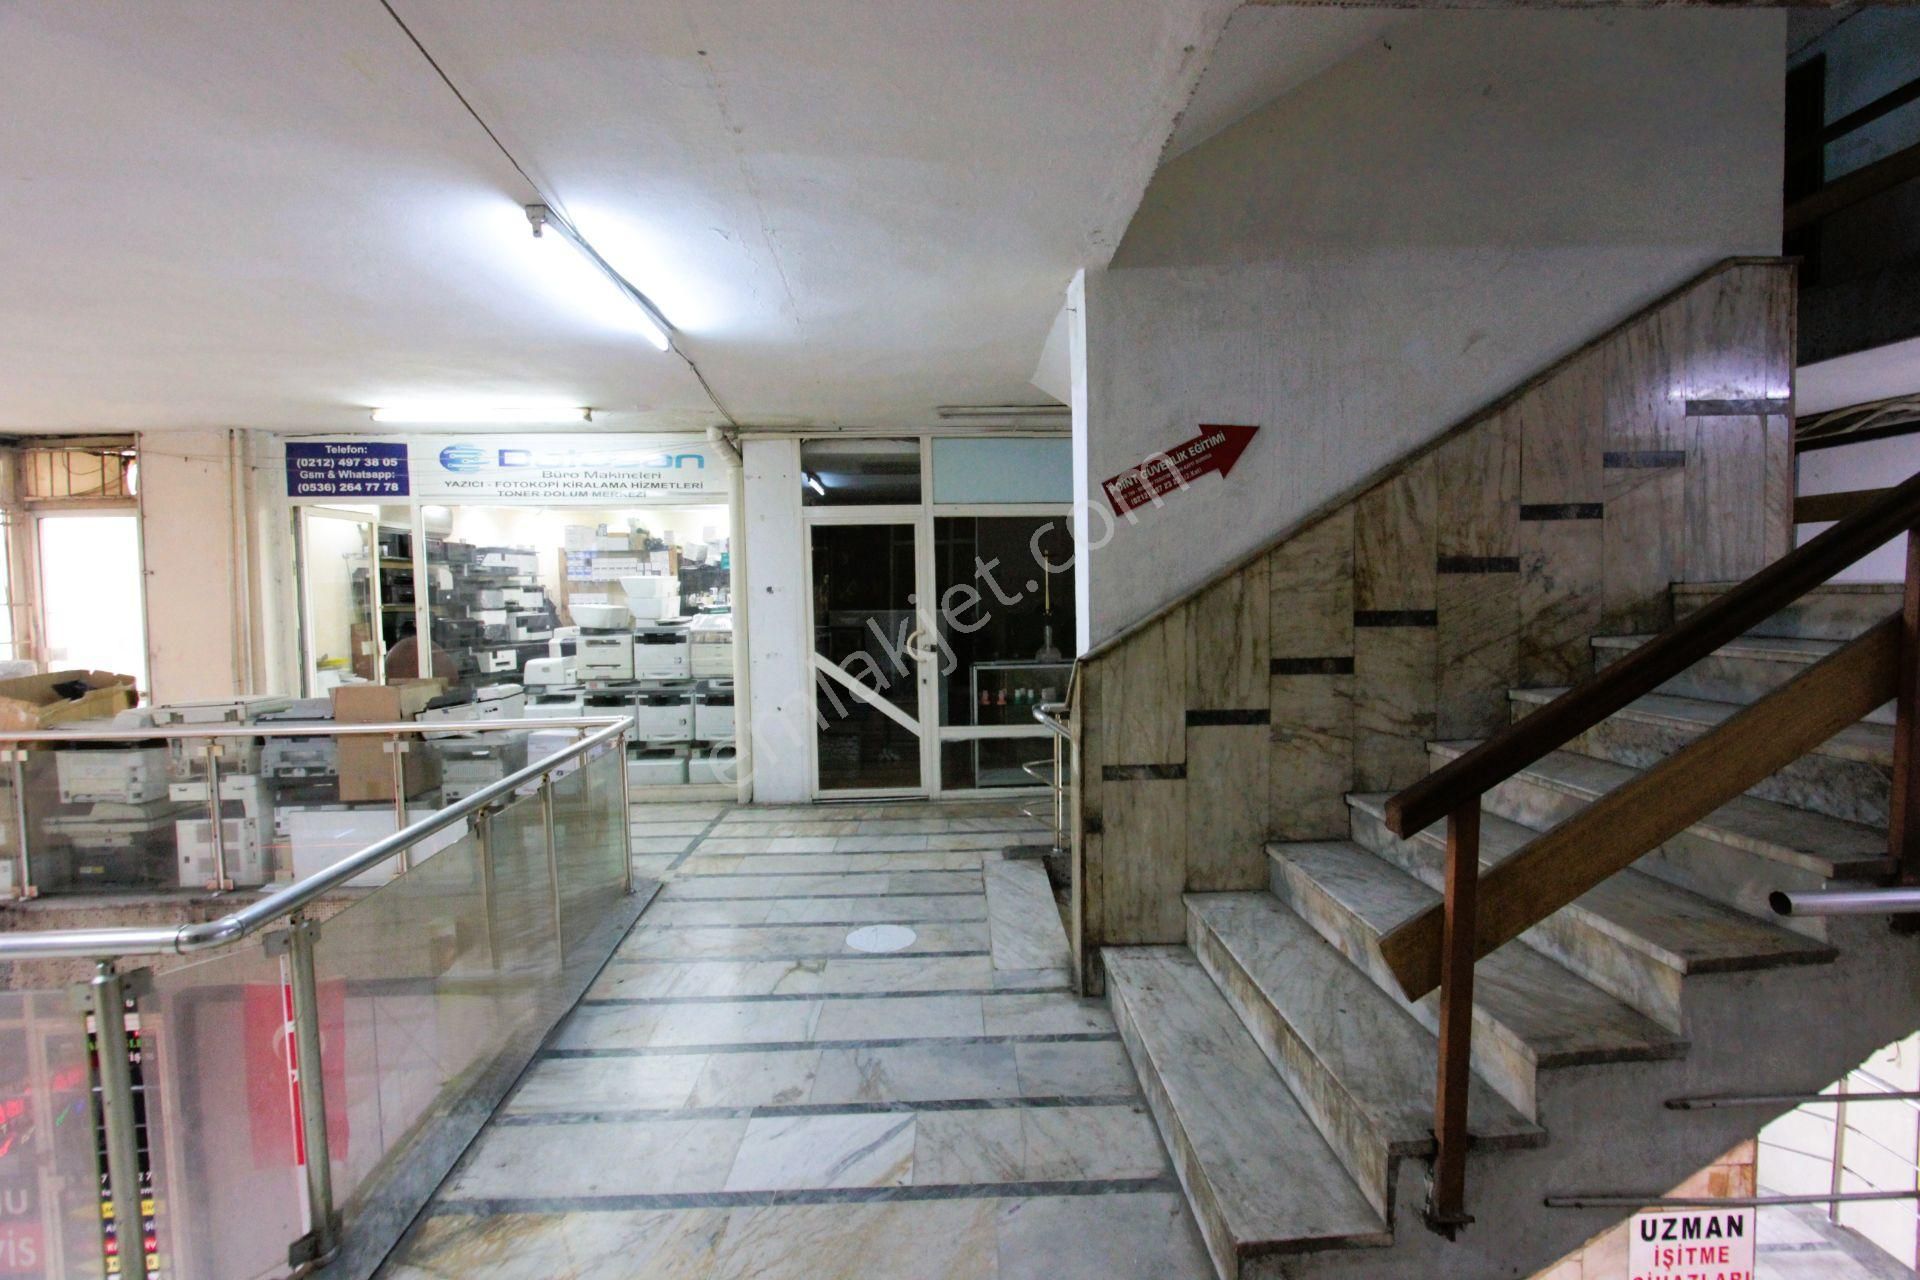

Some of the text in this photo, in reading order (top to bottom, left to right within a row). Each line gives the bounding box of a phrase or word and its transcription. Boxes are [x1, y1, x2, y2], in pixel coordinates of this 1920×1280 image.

[325, 445, 368, 454] Telefon:
[1188, 431, 1226, 457] EĞİTİMİ
[296, 458, 398, 468] (0212) 497 38 05
[300, 470, 396, 481] Gsm & Whatsapp:
[298, 483, 399, 494] (0536) 264 77 78
[444, 480, 485, 488] YAZICI
[495, 480, 559, 489] FOTOKOPİ
[562, 481, 628, 489] KİRALAMA
[630, 481, 704, 489] HİZMETLERİ
[497, 490, 541, 498] TONER
[543, 490, 589, 498] DOLUM
[1641, 1215, 1744, 1242] UZMAN
[1654, 1244, 1729, 1271] İŞİTME
